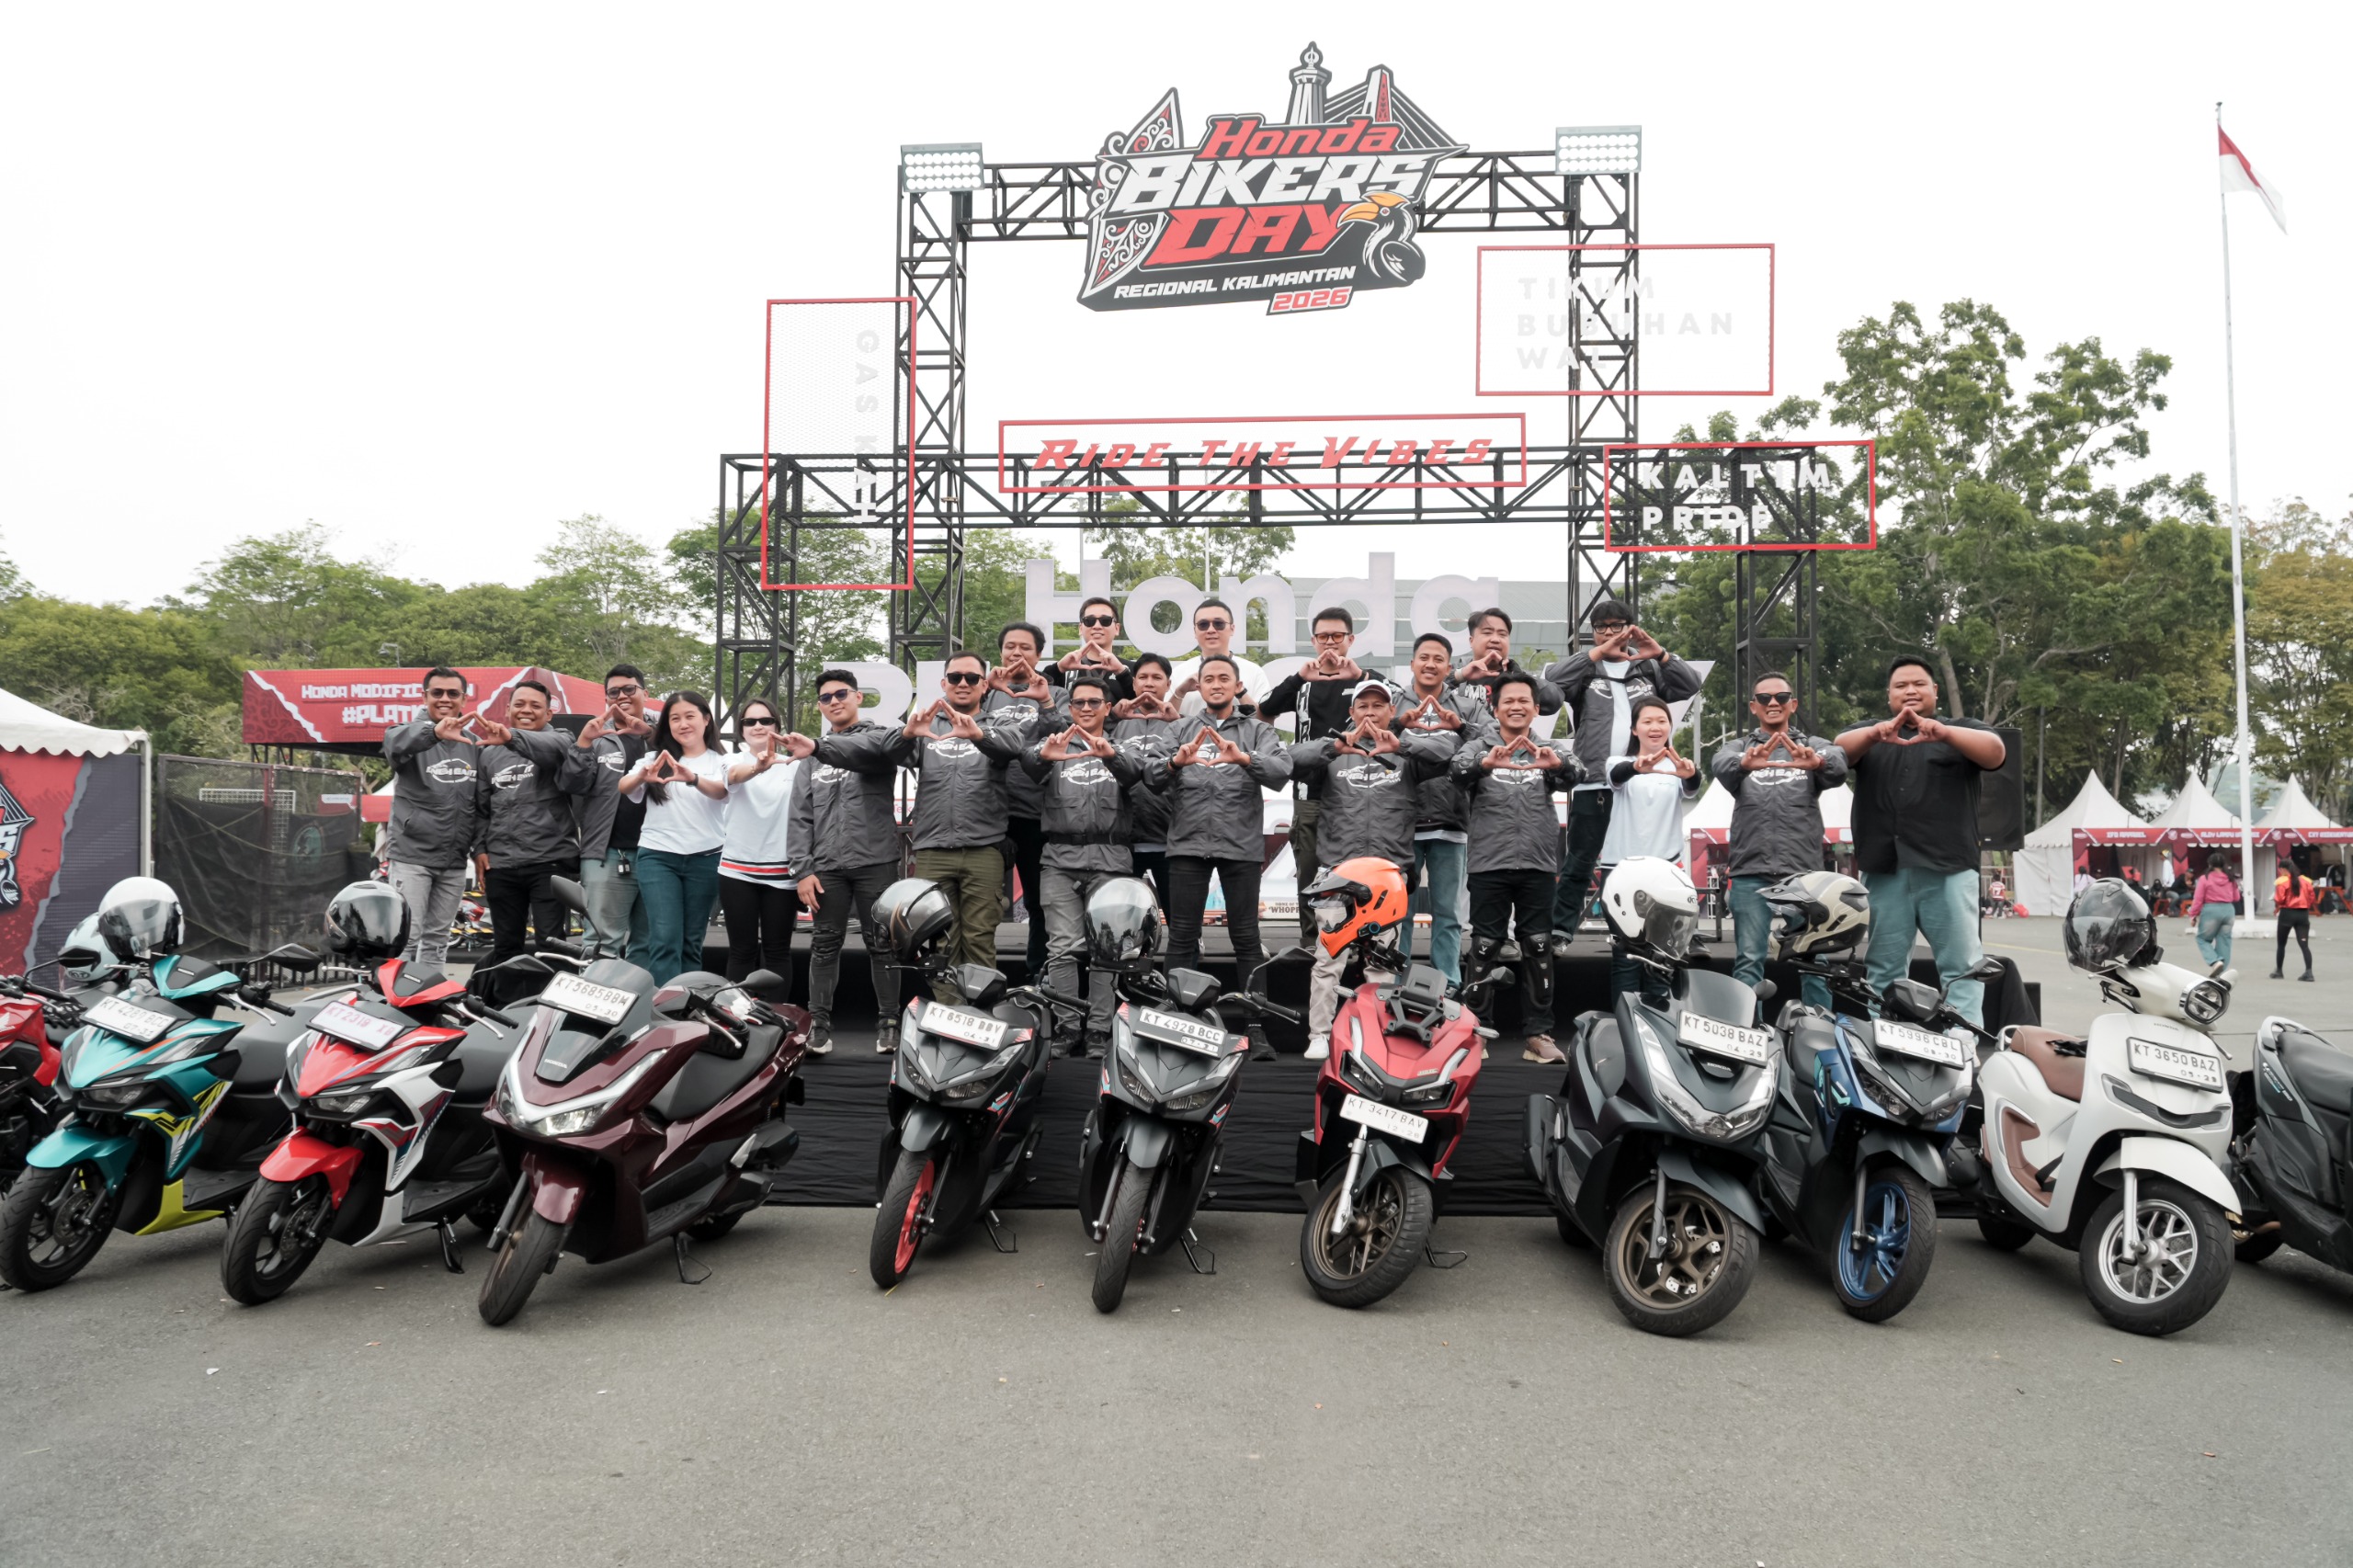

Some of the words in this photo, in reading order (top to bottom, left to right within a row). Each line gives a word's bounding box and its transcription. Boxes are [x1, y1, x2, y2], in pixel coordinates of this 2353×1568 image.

[1196, 119, 1401, 158] Honda
[1109, 153, 1436, 212] BIKERS
[1143, 203, 1353, 266] DAY
[1114, 278, 1218, 299] REGIONAL
[1222, 266, 1356, 291] KALIMANTAN
[1518, 277, 1654, 301] TIKUM
[1272, 289, 1350, 312] 2026
[1517, 312, 1733, 337] BUBUHAN
[1516, 347, 1607, 369] WAL
[1198, 439, 1296, 467] THE
[1320, 436, 1494, 469] VIBES
[1643, 463, 1830, 489] KALTIM
[1643, 506, 1769, 530] PRIDE
[1026, 551, 1499, 659] Honda
[301, 685, 347, 699] HONDA
[554, 976, 574, 989] KT
[572, 982, 606, 999] 5685
[100, 998, 119, 1010] KT
[929, 1006, 946, 1018] KT
[1143, 1012, 1161, 1025] KT
[1164, 1019, 1195, 1034] 4928
[1198, 1027, 1221, 1041] BCC
[1684, 1015, 1699, 1028] KT
[1703, 1020, 1734, 1040] 5038
[1738, 1030, 1763, 1047] BAZ
[1880, 1024, 1895, 1035] KT
[2133, 1043, 2150, 1056] KT
[2154, 1048, 2188, 1066] 3650
[2191, 1056, 2216, 1072] BAZ
[1347, 1097, 1364, 1109] KT
[1369, 1104, 1397, 1119] 3417
[1400, 1114, 1424, 1129] BAV
